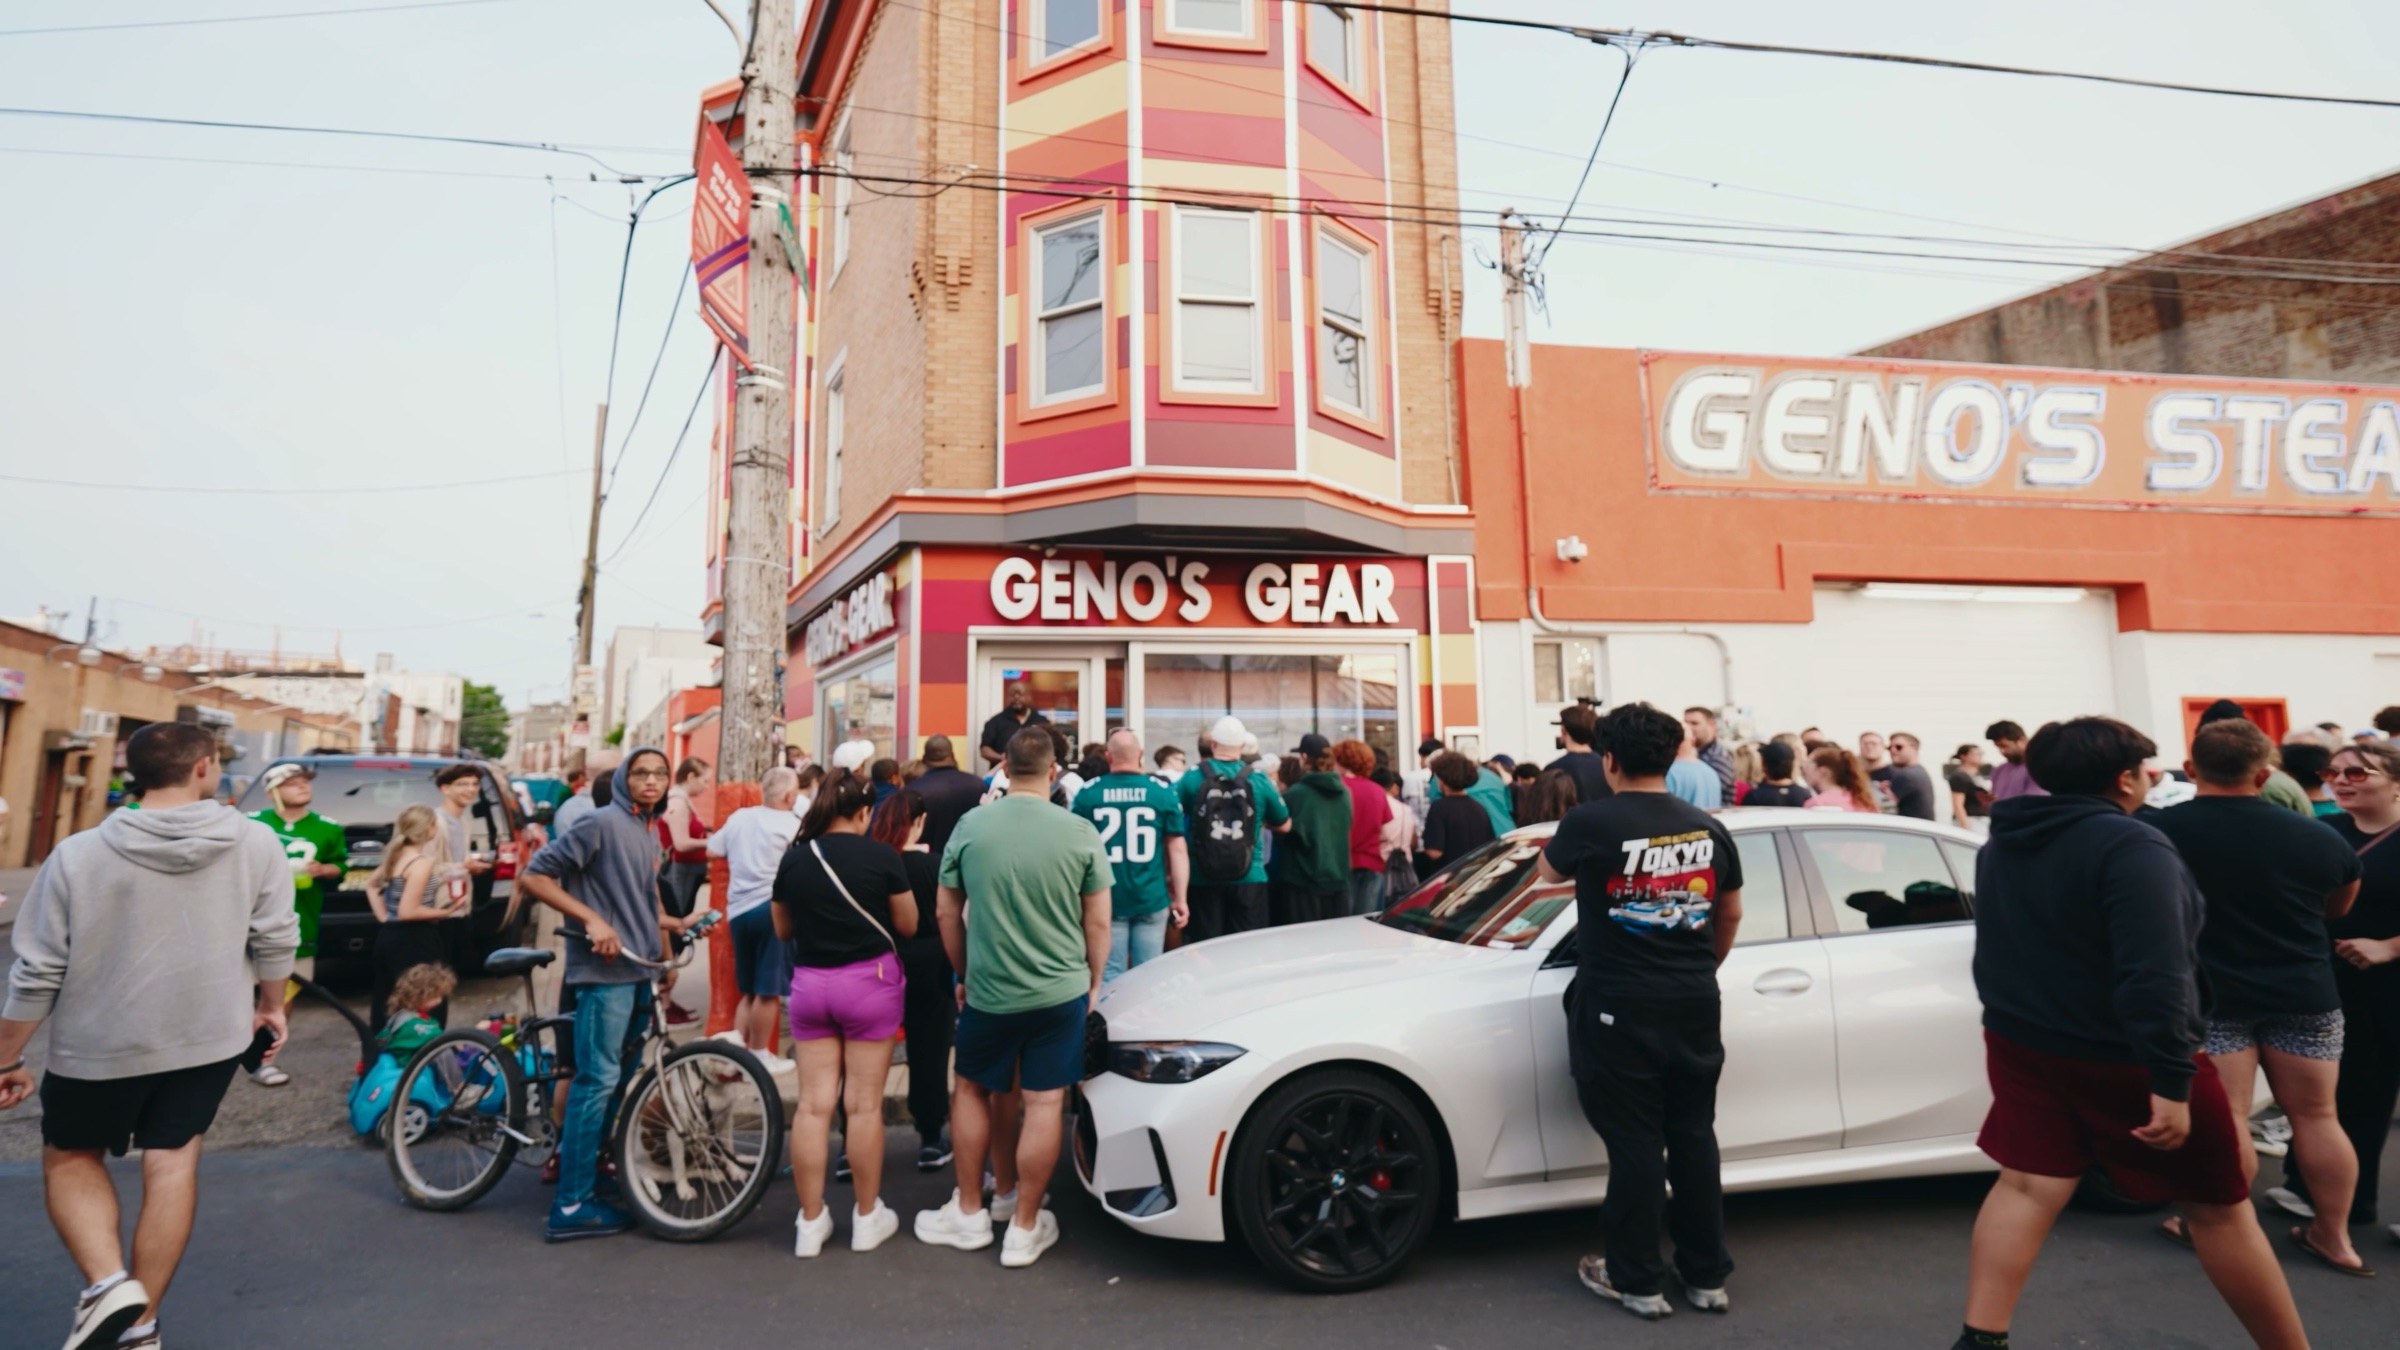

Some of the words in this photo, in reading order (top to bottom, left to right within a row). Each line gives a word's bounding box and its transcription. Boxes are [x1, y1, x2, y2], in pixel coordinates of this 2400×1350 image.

[1665, 371, 2106, 486] GENO'S
[2148, 394, 2400, 493] STEA
[847, 571, 895, 644] GEAR
[990, 556, 1213, 623] GENO'S
[1244, 562, 1400, 625] GEAR
[1093, 806, 1156, 863] 26
